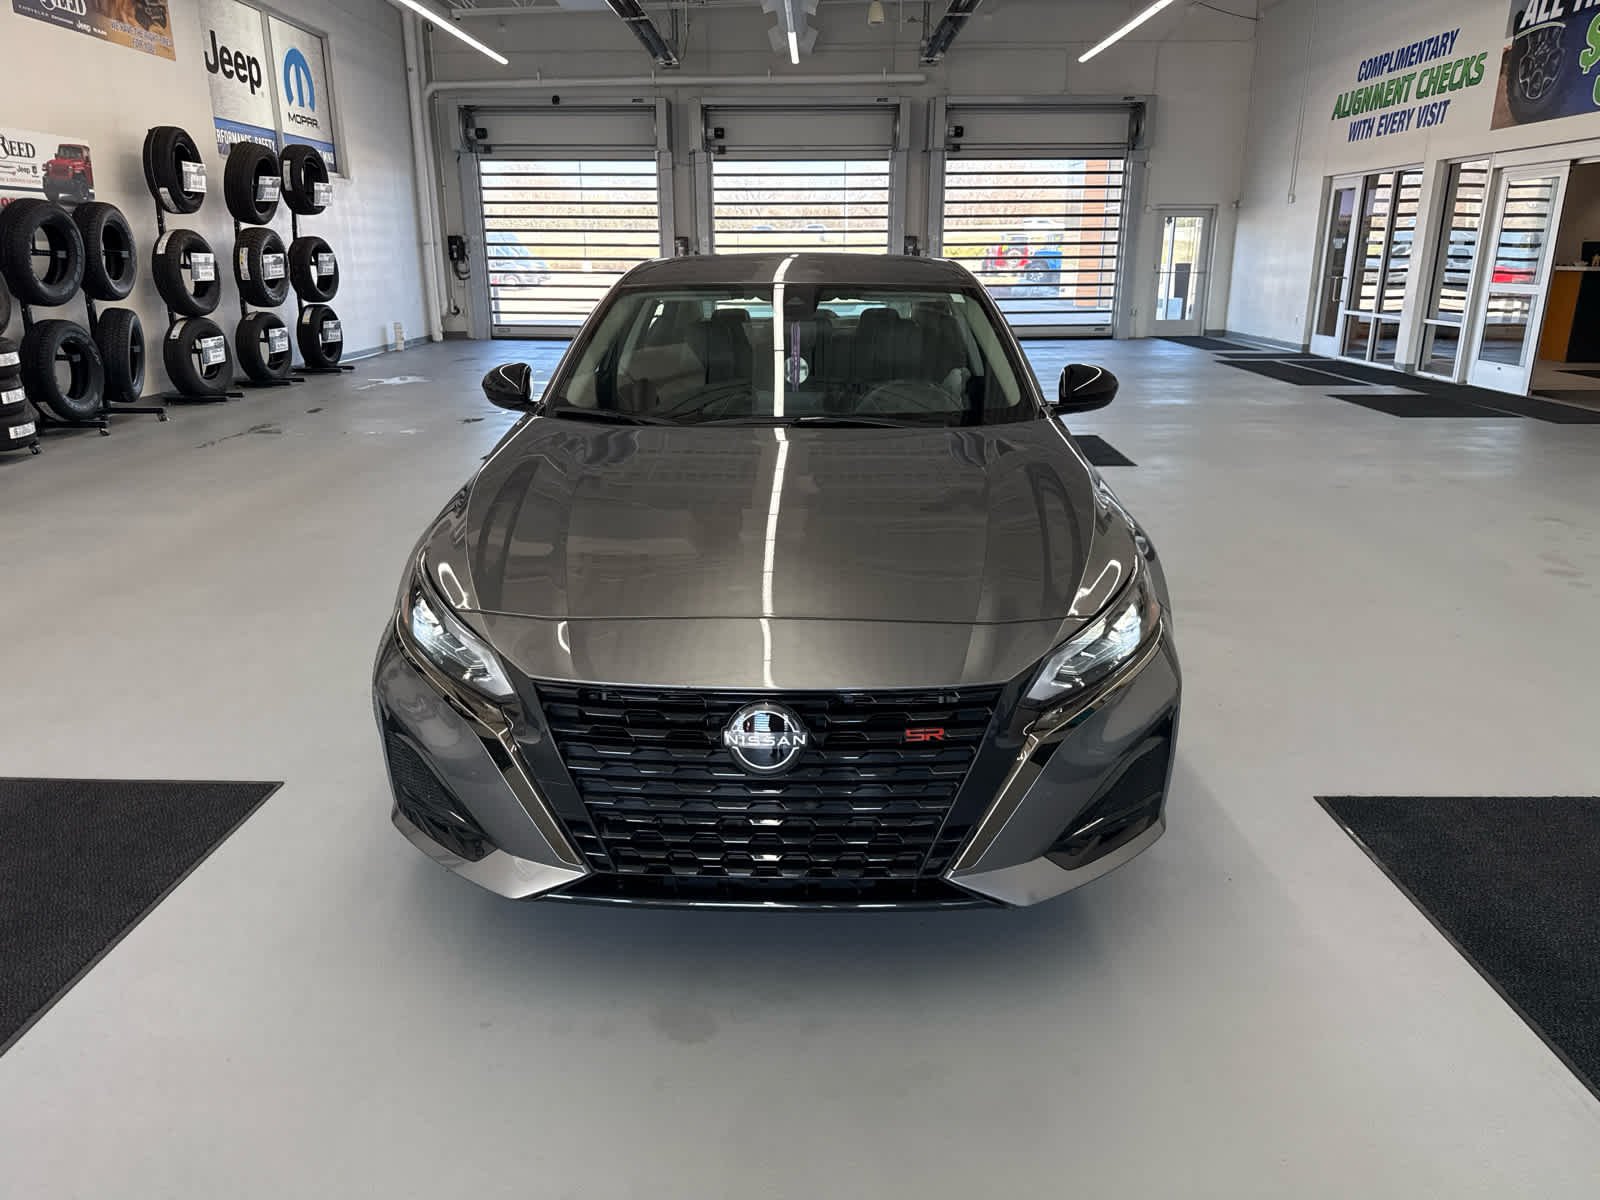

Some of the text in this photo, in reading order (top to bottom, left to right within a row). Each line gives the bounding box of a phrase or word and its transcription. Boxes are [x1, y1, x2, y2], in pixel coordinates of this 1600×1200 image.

[1519, 0, 1565, 28] ALL
[204, 29, 262, 95] Jeep
[1357, 28, 1461, 83] COMPLIMENTARY
[1331, 51, 1488, 121] ALIGNMENT CHECKS
[287, 111, 318, 128] MOPAR
[1347, 99, 1451, 143] WITH EVERY VISIT
[724, 729, 808, 746] NISSAN
[905, 728, 945, 742] SR
